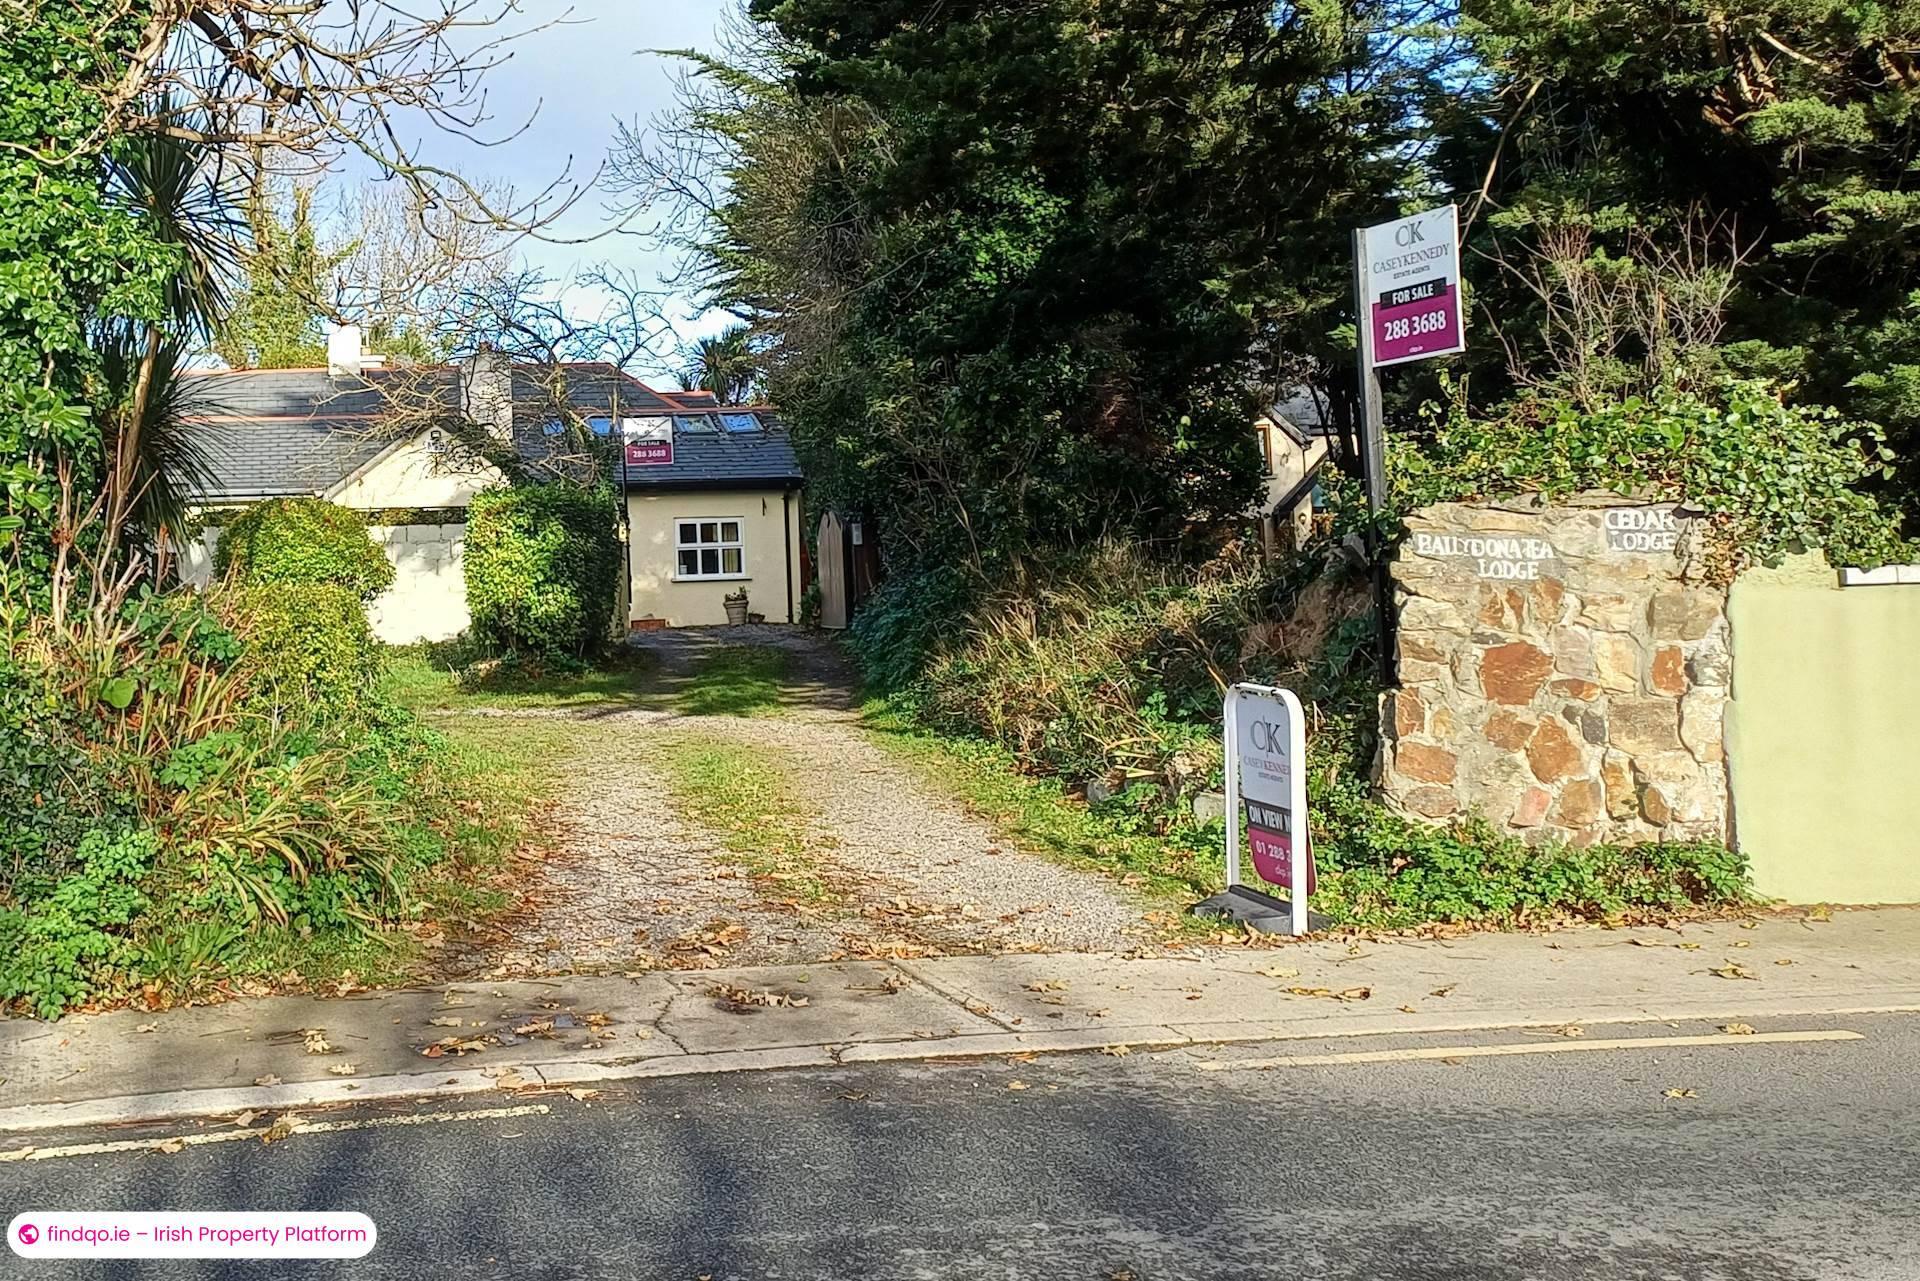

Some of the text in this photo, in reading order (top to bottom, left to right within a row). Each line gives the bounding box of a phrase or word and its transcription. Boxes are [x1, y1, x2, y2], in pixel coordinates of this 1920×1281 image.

[1373, 243, 1450, 274] CASEYKENNEDY
[1392, 283, 1434, 305] FOR SALE
[1384, 310, 1447, 341] 288 3688
[632, 449, 666, 458] 288 3688
[1604, 509, 1677, 531] CEDAR
[1609, 530, 1677, 551] LODGE
[1477, 559, 1540, 580] LODGE
[1249, 805, 1262, 824] ON
[1261, 808, 1283, 830] VIEW
[1256, 840, 1266, 855] 01
[1268, 844, 1285, 861] 288
